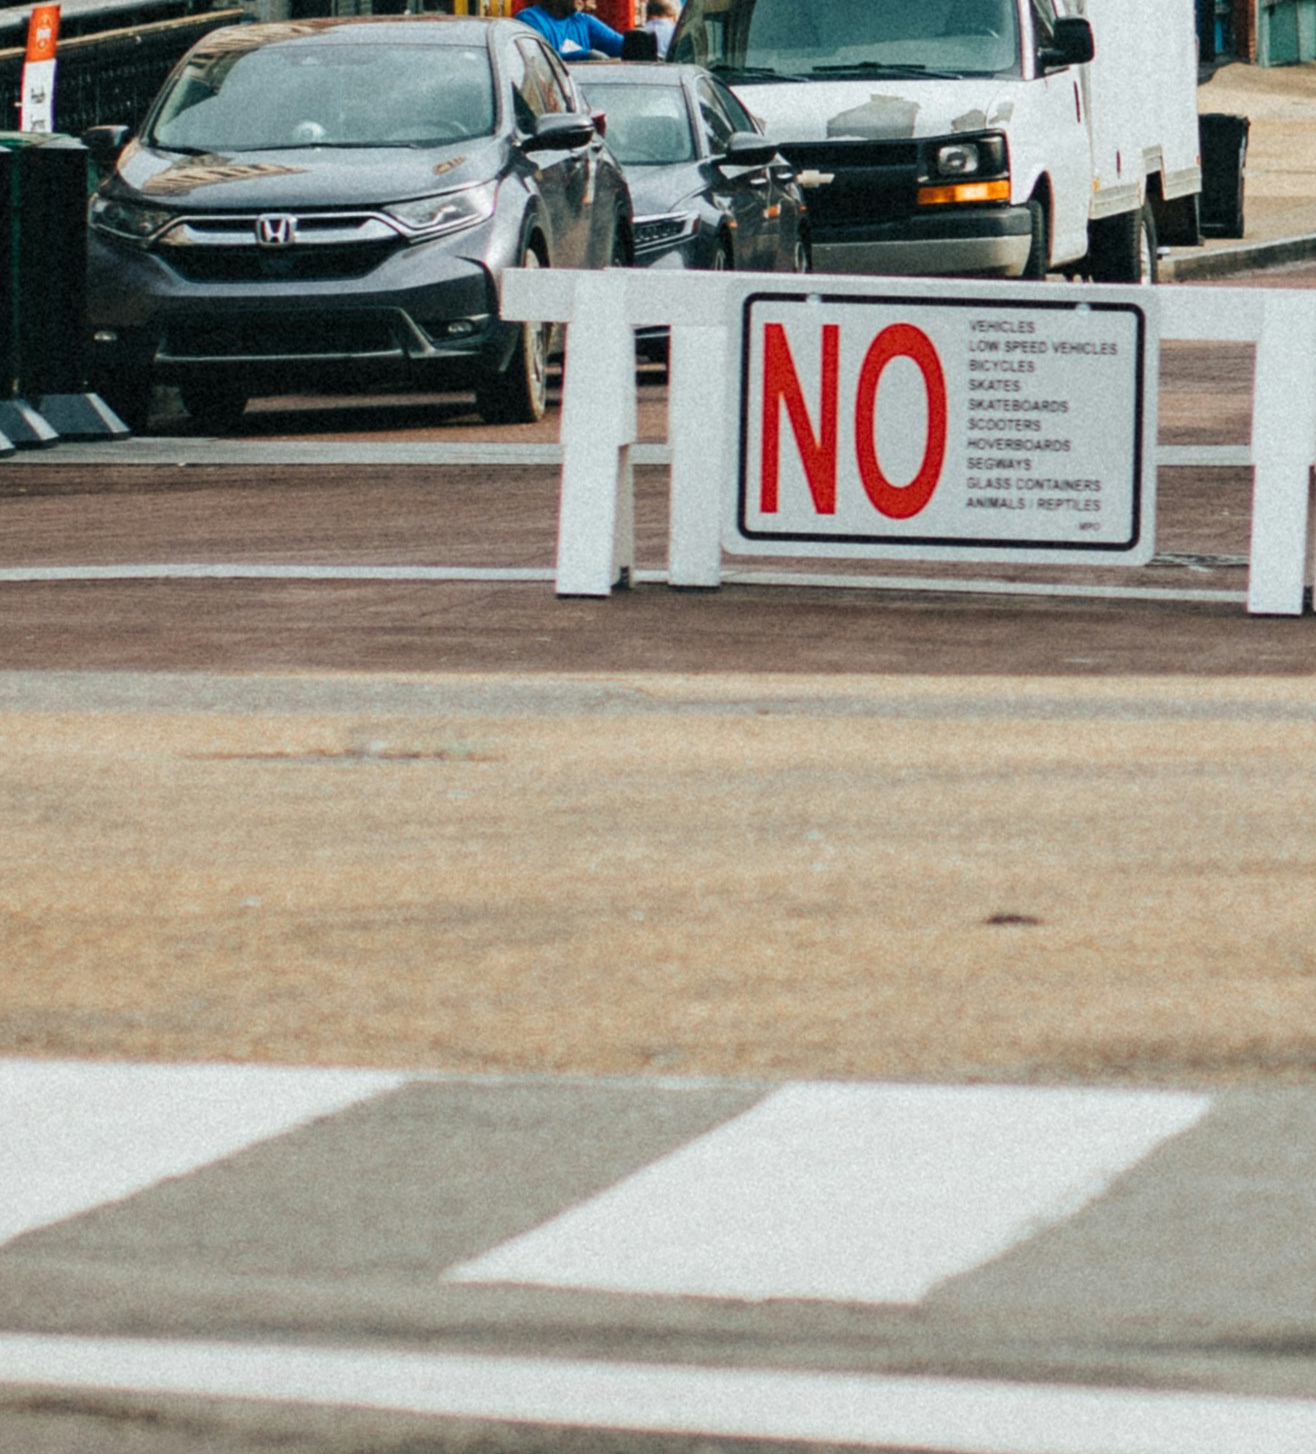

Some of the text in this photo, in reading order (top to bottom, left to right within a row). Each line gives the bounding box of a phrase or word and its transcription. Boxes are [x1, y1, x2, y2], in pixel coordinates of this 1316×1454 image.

[969, 320, 1036, 334] VEHICLES
[968, 340, 1118, 355] LOW SPEED VEHICLES
[968, 360, 1036, 373] BICYCLES
[968, 379, 1021, 392] SKATES
[967, 398, 1069, 413] SKATEBOARDS
[760, 322, 948, 520] NO
[967, 418, 1042, 432] SCOOTERS
[967, 438, 1071, 452] HOVERBOARDS
[966, 457, 1033, 471] SEGWAYS
[966, 477, 1102, 492] GLASS CONTAINERS
[965, 497, 1026, 510] ANIMALS
[1037, 499, 1102, 512] REPTILES
